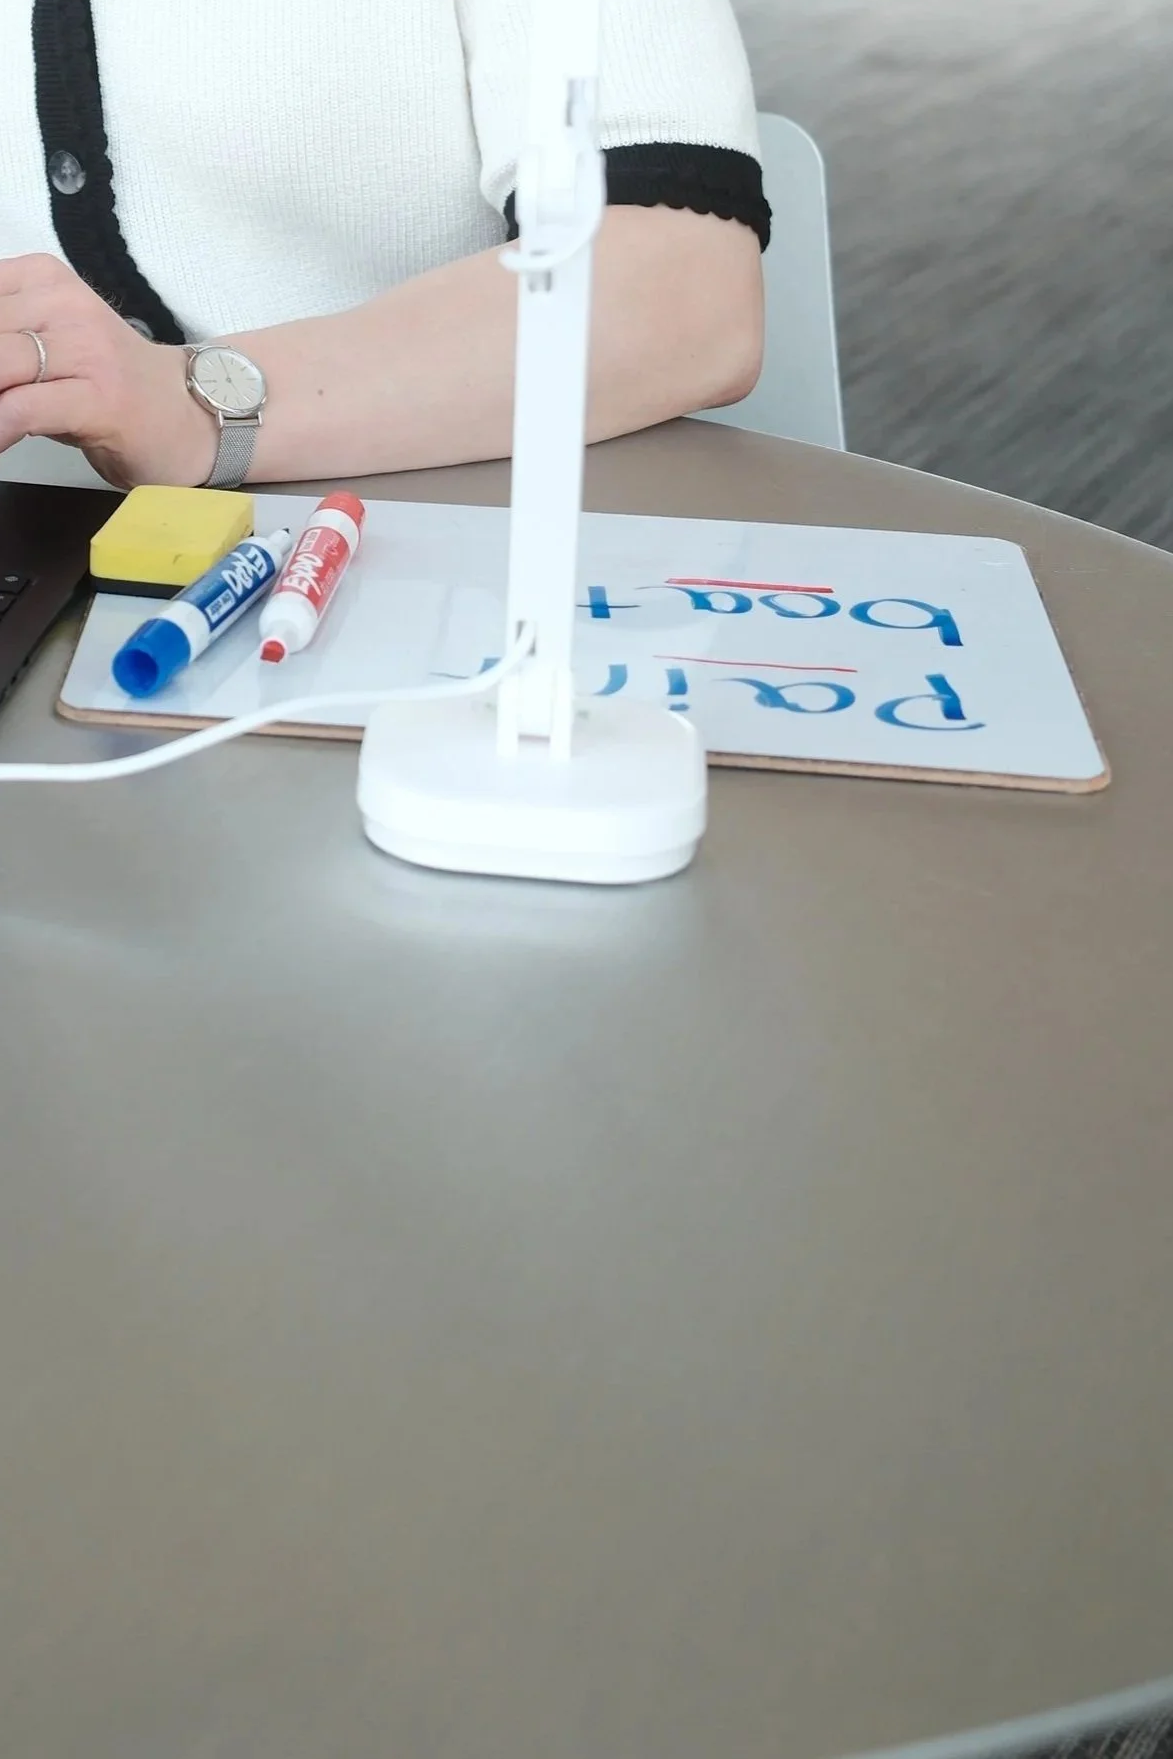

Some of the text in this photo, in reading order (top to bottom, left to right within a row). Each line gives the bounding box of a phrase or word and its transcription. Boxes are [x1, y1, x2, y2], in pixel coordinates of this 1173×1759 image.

[221, 546, 268, 598] EXPO
[281, 552, 324, 597] EXPO
[576, 585, 964, 647] boat
